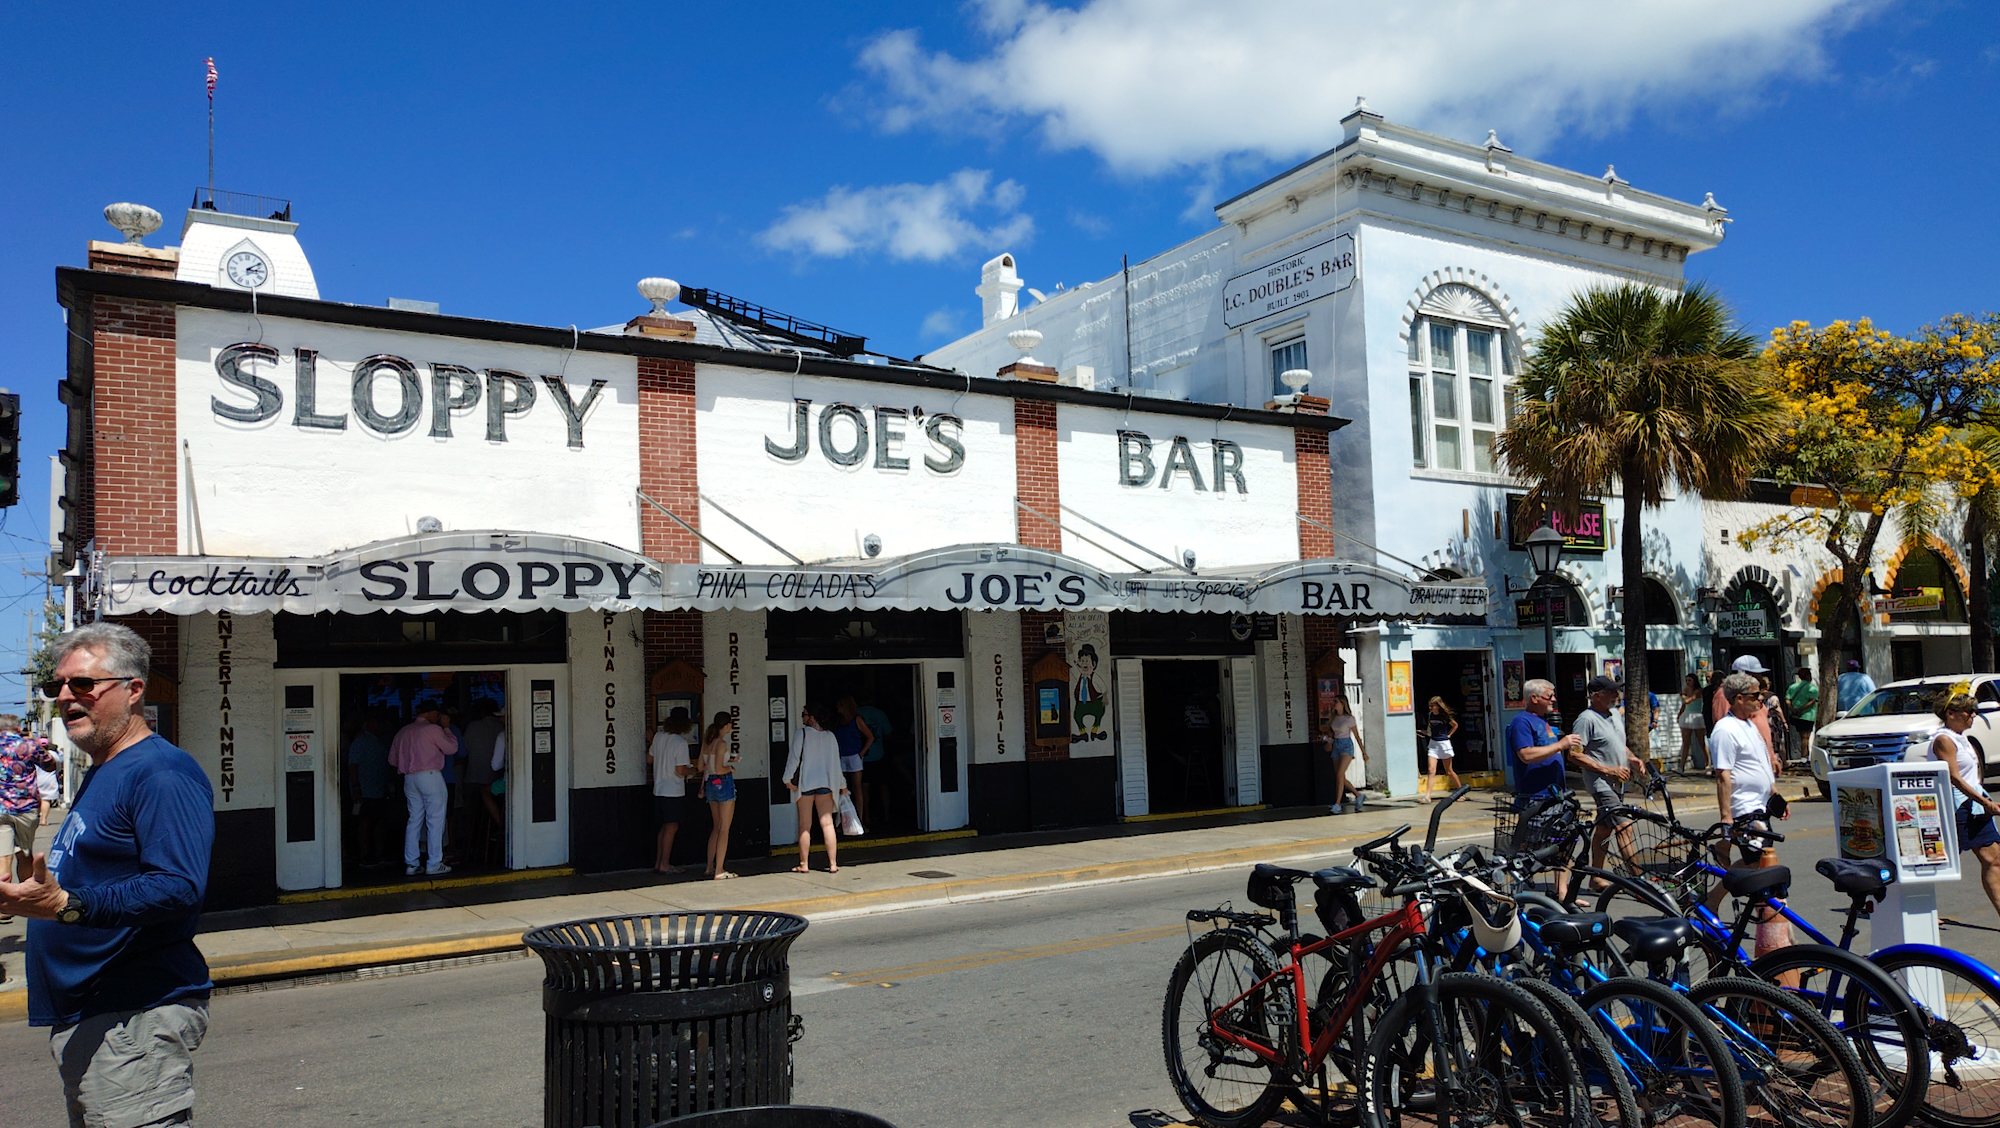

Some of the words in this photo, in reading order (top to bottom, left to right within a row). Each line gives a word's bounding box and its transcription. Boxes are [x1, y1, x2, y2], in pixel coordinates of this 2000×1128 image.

[1225, 293, 1245, 312] I.C.
[1250, 266, 1315, 304] DOUBLE'S
[1321, 252, 1353, 277] BAR
[1268, 256, 1306, 277] HISTORIC
[1267, 297, 1289, 312] BUILT
[1293, 290, 1310, 302] 1901
[211, 342, 608, 448] SLOPPY
[764, 398, 967, 474] JOE'S
[1117, 429, 1249, 494] BAR
[148, 566, 308, 597] Cocktails
[360, 560, 645, 601] SLOPPY
[697, 571, 749, 599] PINA
[767, 572, 878, 599] COLADA'S
[945, 572, 1086, 606] JOE'S
[1113, 581, 1149, 597] SLOPPY
[1162, 581, 1189, 598] JOE'S
[1301, 582, 1373, 610] BAR
[1410, 588, 1456, 604] DRAUGHT
[1460, 589, 1486, 604] BEER
[1518, 601, 1534, 615] TIKI
[1731, 619, 1763, 628] GREEEN
[1732, 627, 1761, 636] HOUSE
[729, 632, 739, 695] DRAFT
[1280, 612, 1292, 739] ENTERTAINMENT
[218, 609, 234, 802] ENTERTAINMENT
[994, 654, 1005, 754] COCKTAILS
[605, 683, 616, 774] COLADAS
[730, 706, 740, 754] BEER
[1899, 778, 1932, 788] FREE
[1365, 1054, 1376, 1114] MAXXIS
